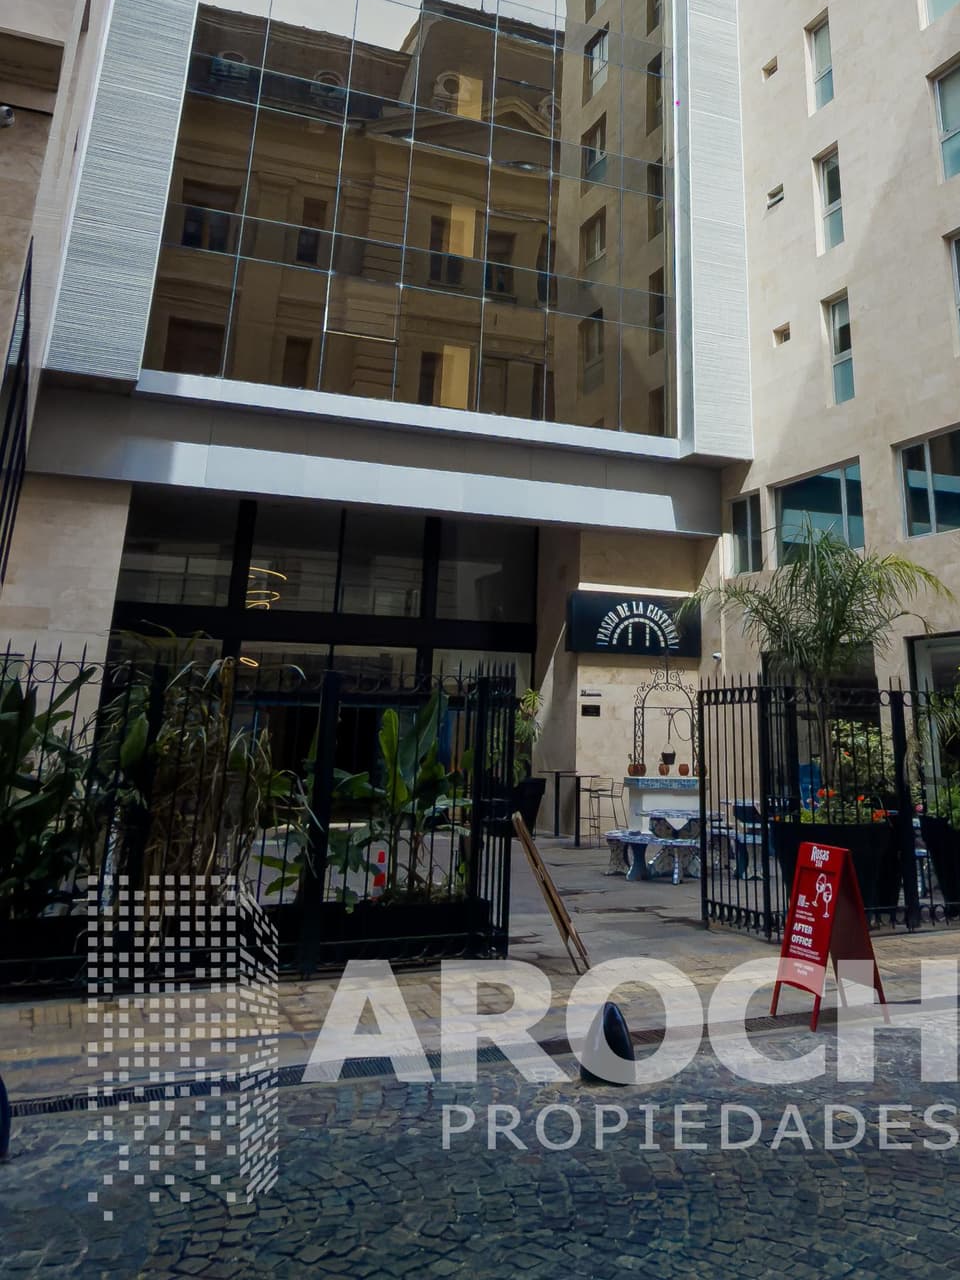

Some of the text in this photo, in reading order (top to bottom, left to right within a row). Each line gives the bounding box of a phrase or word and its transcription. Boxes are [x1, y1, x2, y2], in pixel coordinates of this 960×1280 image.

[596, 601, 680, 645] PASEO DE LA CISTERNA
[793, 922, 813, 935] AFTER
[791, 934, 813, 948] OFFICE
